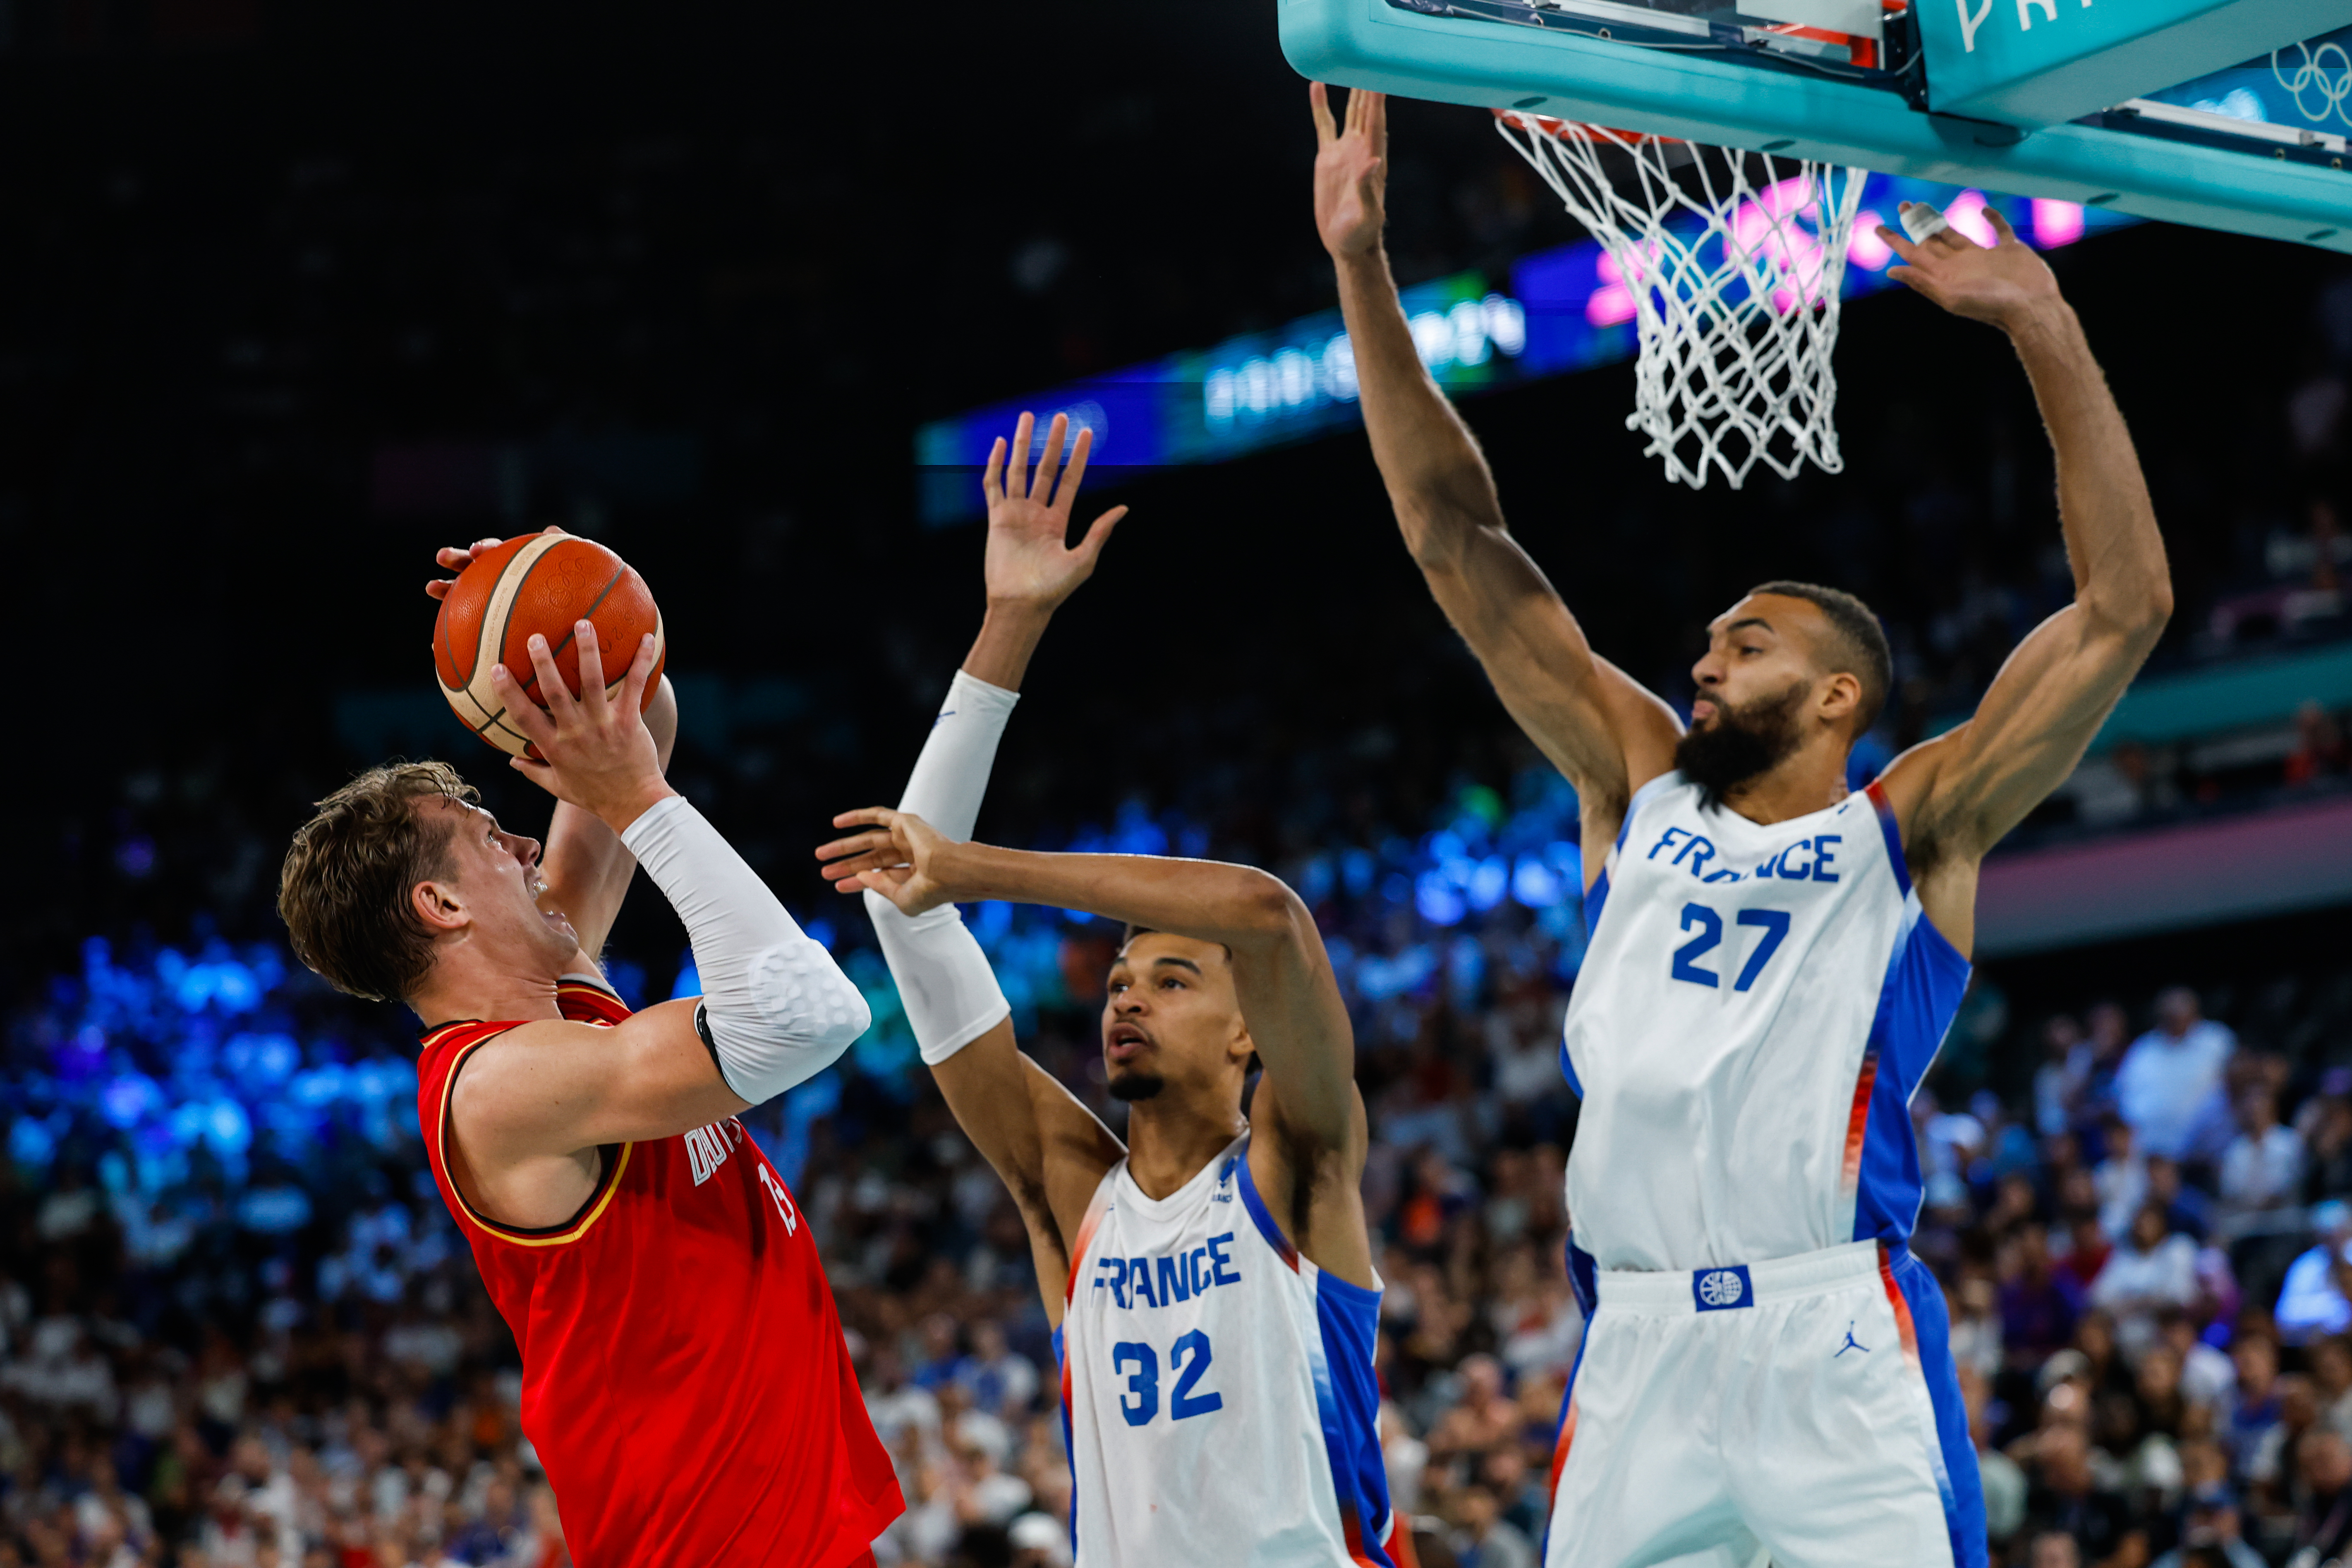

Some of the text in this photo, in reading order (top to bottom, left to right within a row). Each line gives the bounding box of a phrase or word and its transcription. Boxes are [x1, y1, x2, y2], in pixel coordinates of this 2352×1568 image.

[1672, 901, 1790, 993] 27
[1090, 1231, 1241, 1309] FRANCE
[1113, 1328, 1223, 1427] 32
